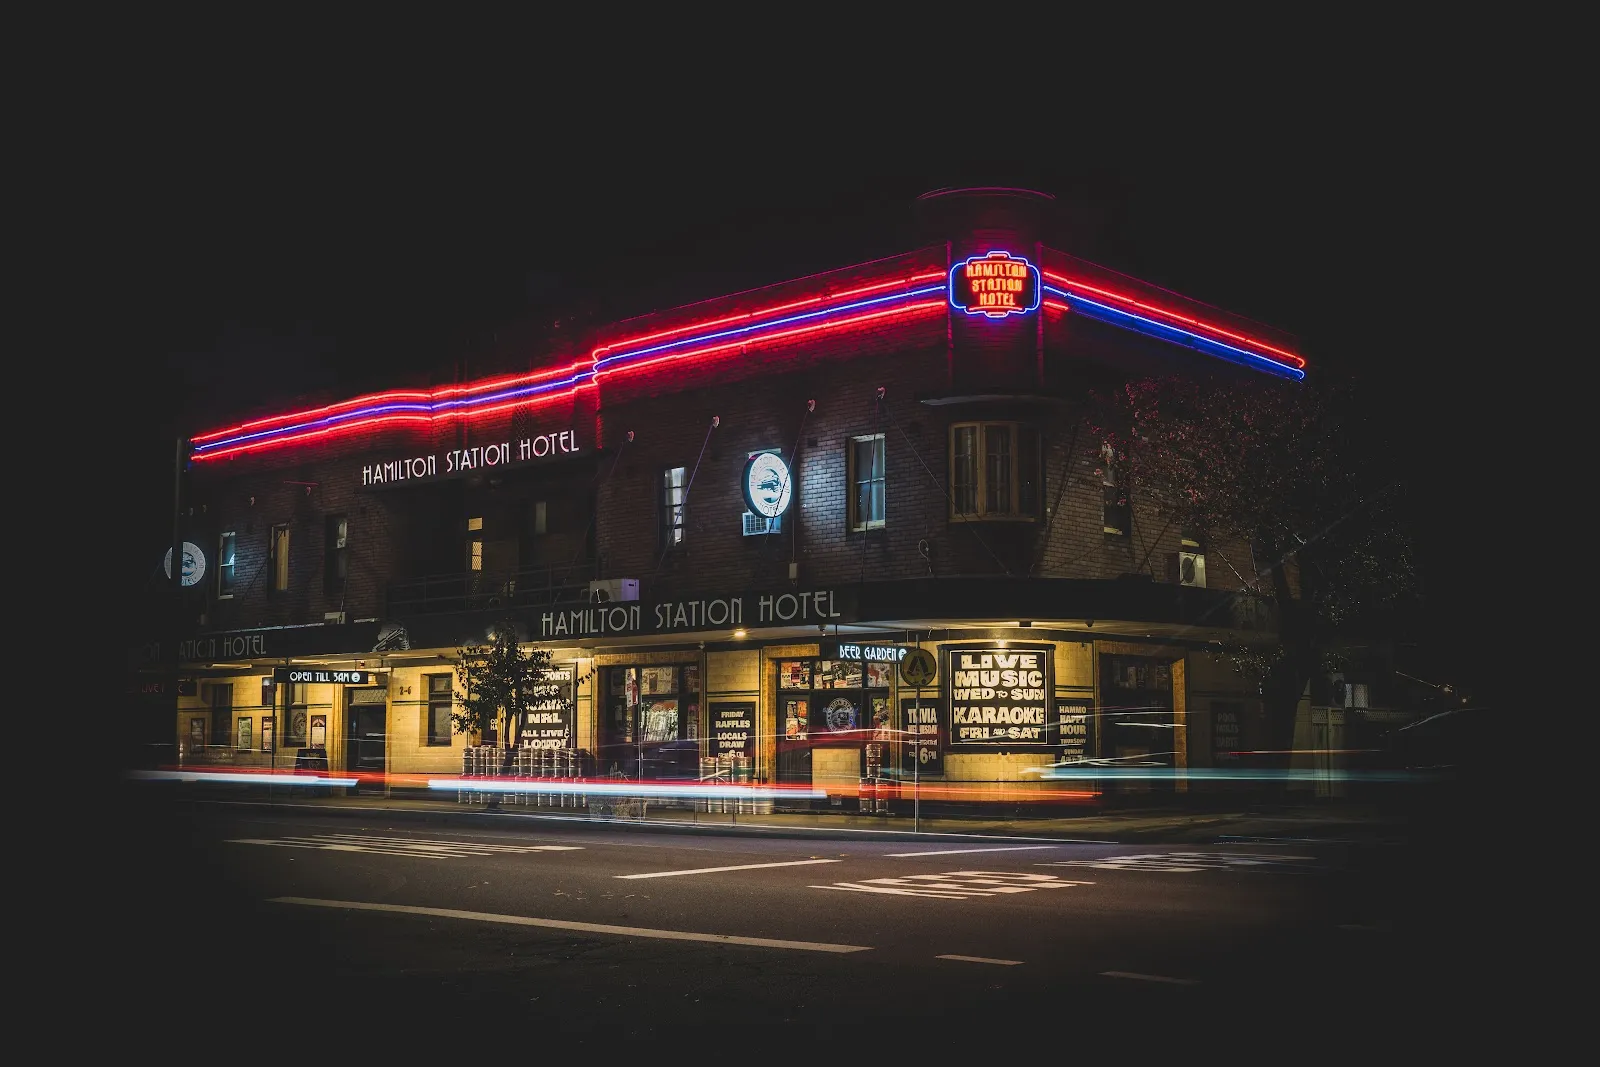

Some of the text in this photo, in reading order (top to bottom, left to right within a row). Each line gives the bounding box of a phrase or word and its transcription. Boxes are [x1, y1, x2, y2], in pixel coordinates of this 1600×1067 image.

[966, 263, 1026, 277] HAMILTON
[972, 278, 1022, 291] STATION
[980, 292, 1015, 306] HOTEL
[362, 430, 580, 486] HAMILTON STATION HOTEL
[541, 590, 841, 637] HAMILTON STATION HOTEL
[223, 634, 267, 657] HOTEL
[839, 644, 897, 661] BEER GARDEN
[960, 654, 1038, 669] LIVE
[289, 671, 350, 682] OPEN TILL 3AM
[954, 670, 1043, 688] MUSIC
[953, 687, 1045, 701] WED TO SUN
[953, 706, 1045, 725] KARAOKE
[1059, 705, 1087, 714] HAMMO
[527, 713, 562, 724] NRL
[715, 719, 751, 728] RAFFLES
[1059, 714, 1087, 723] HAPPY
[521, 729, 539, 738] ALL
[540, 729, 563, 738] LIVE
[717, 731, 748, 740] LOCALS
[959, 727, 990, 739] FRI
[1007, 726, 1041, 739] SAT
[1059, 724, 1087, 735] HOUR
[719, 740, 746, 749] DRAW
